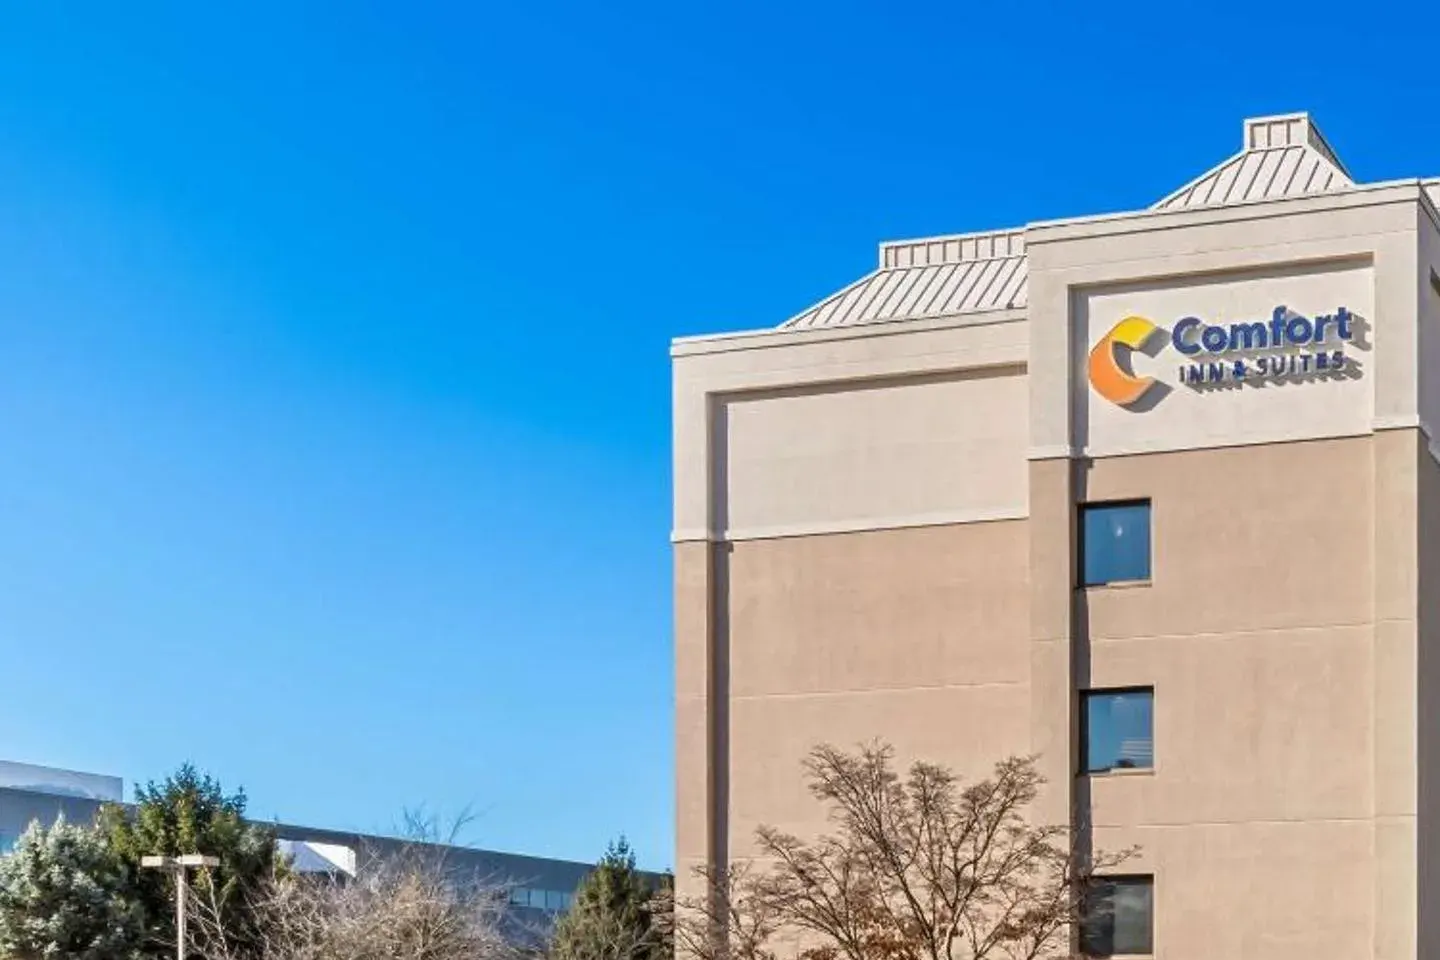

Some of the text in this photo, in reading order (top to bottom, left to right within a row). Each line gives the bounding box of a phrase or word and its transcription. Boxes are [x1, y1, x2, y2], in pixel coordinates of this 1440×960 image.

[1172, 304, 1352, 355] Comfort
[1179, 351, 1345, 384] INN & SUITES
